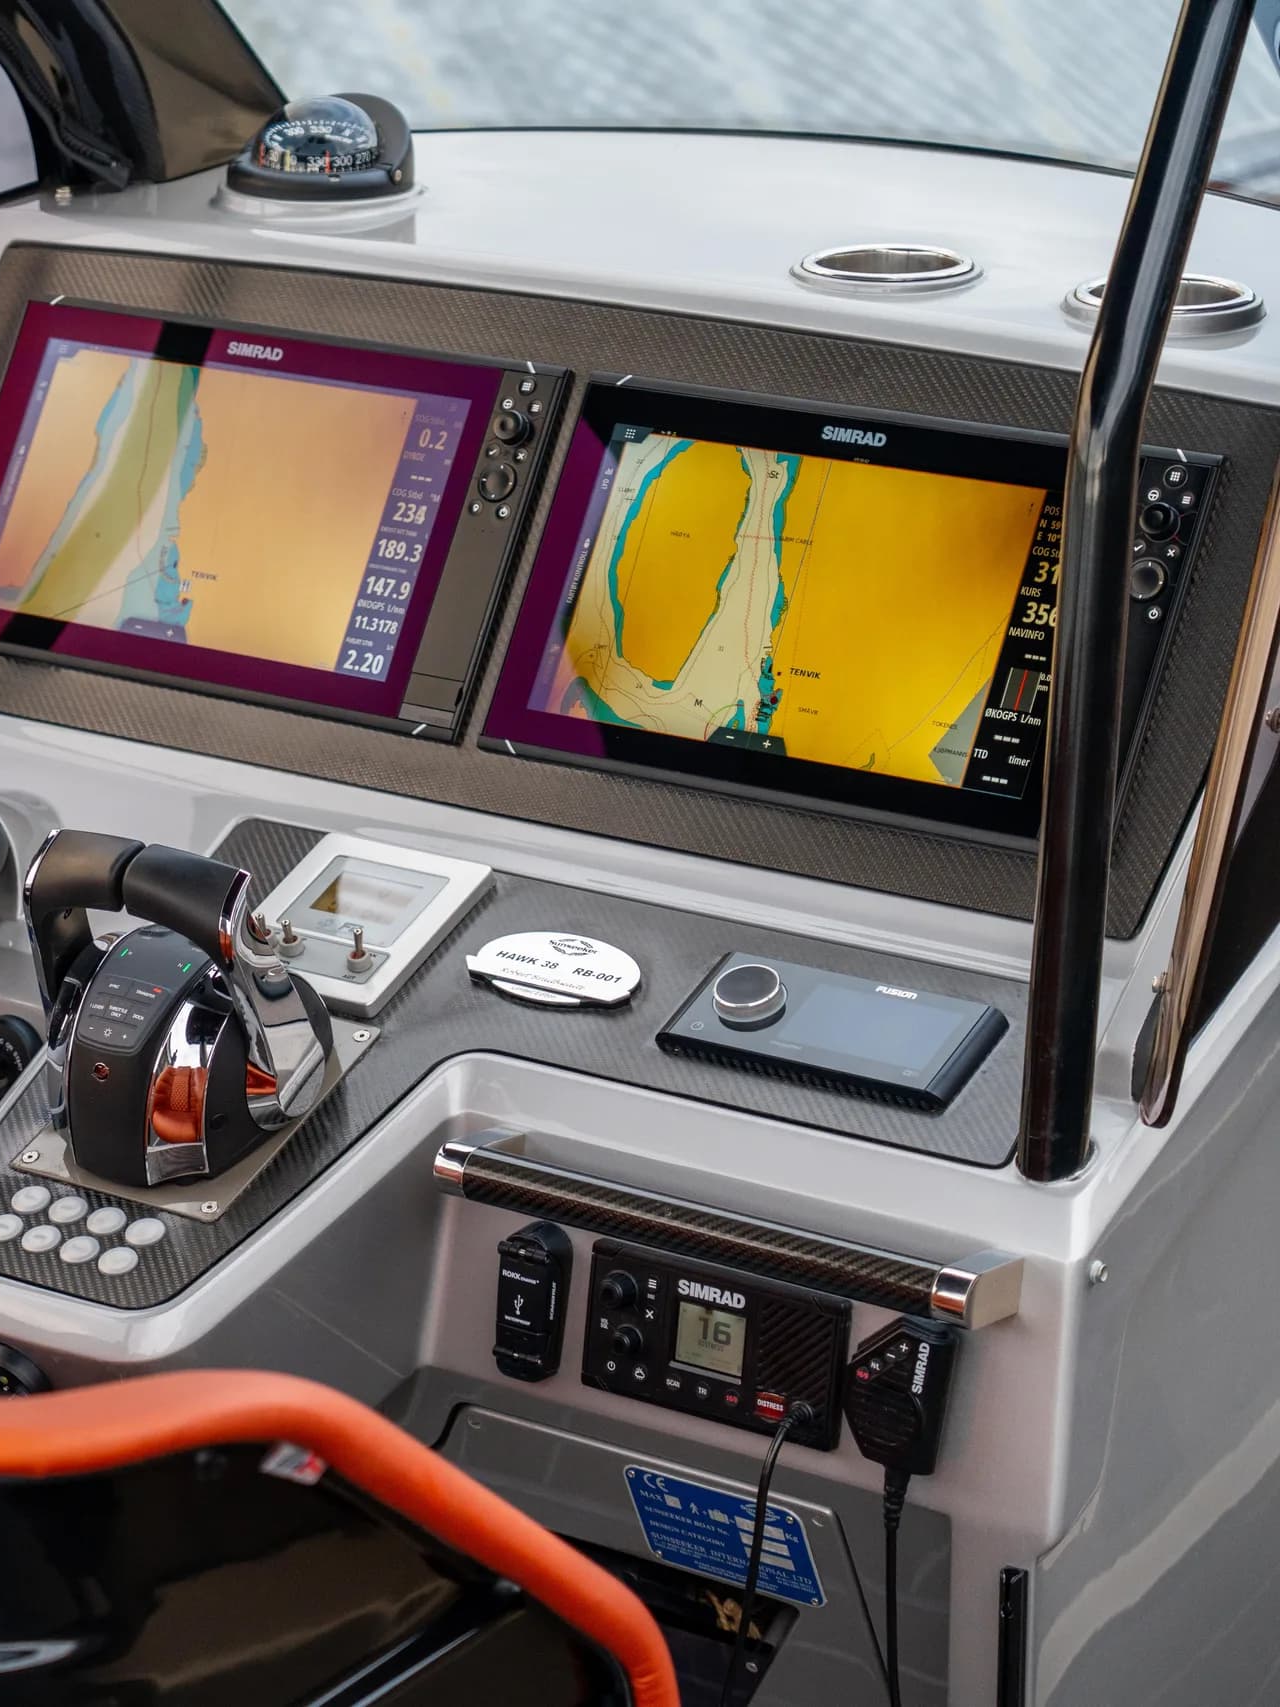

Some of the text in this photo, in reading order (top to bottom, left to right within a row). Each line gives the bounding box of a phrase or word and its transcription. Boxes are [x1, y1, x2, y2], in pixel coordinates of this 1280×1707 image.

[333, 154, 354, 167] 300
[227, 341, 284, 361] SIMRAD
[419, 428, 448, 450] 0.2
[821, 425, 887, 447] SIMRAD
[1044, 505, 1061, 516] POS
[1039, 518, 1048, 528] N
[378, 538, 423, 563] 189.3
[1032, 545, 1050, 557] COG
[366, 575, 411, 600] 147.9
[1020, 585, 1042, 598] KURS
[354, 615, 399, 636] 11.3178
[1008, 626, 1046, 641] NAVINFO
[343, 649, 385, 675] 2.20
[790, 667, 821, 680] TENVIK
[984, 706, 1042, 727] ØKOGPS L/nm
[973, 747, 1031, 768] TTD timer
[496, 950, 623, 984] HAWK 38 RB-001
[677, 1279, 746, 1309] SIMRAD
[911, 1342, 930, 1394] SIMRAD
[666, 1378, 680, 1389] SCAN
[698, 1386, 708, 1396] TRI
[757, 1398, 784, 1412] DISTRESS
[640, 1489, 664, 1502] MAX
